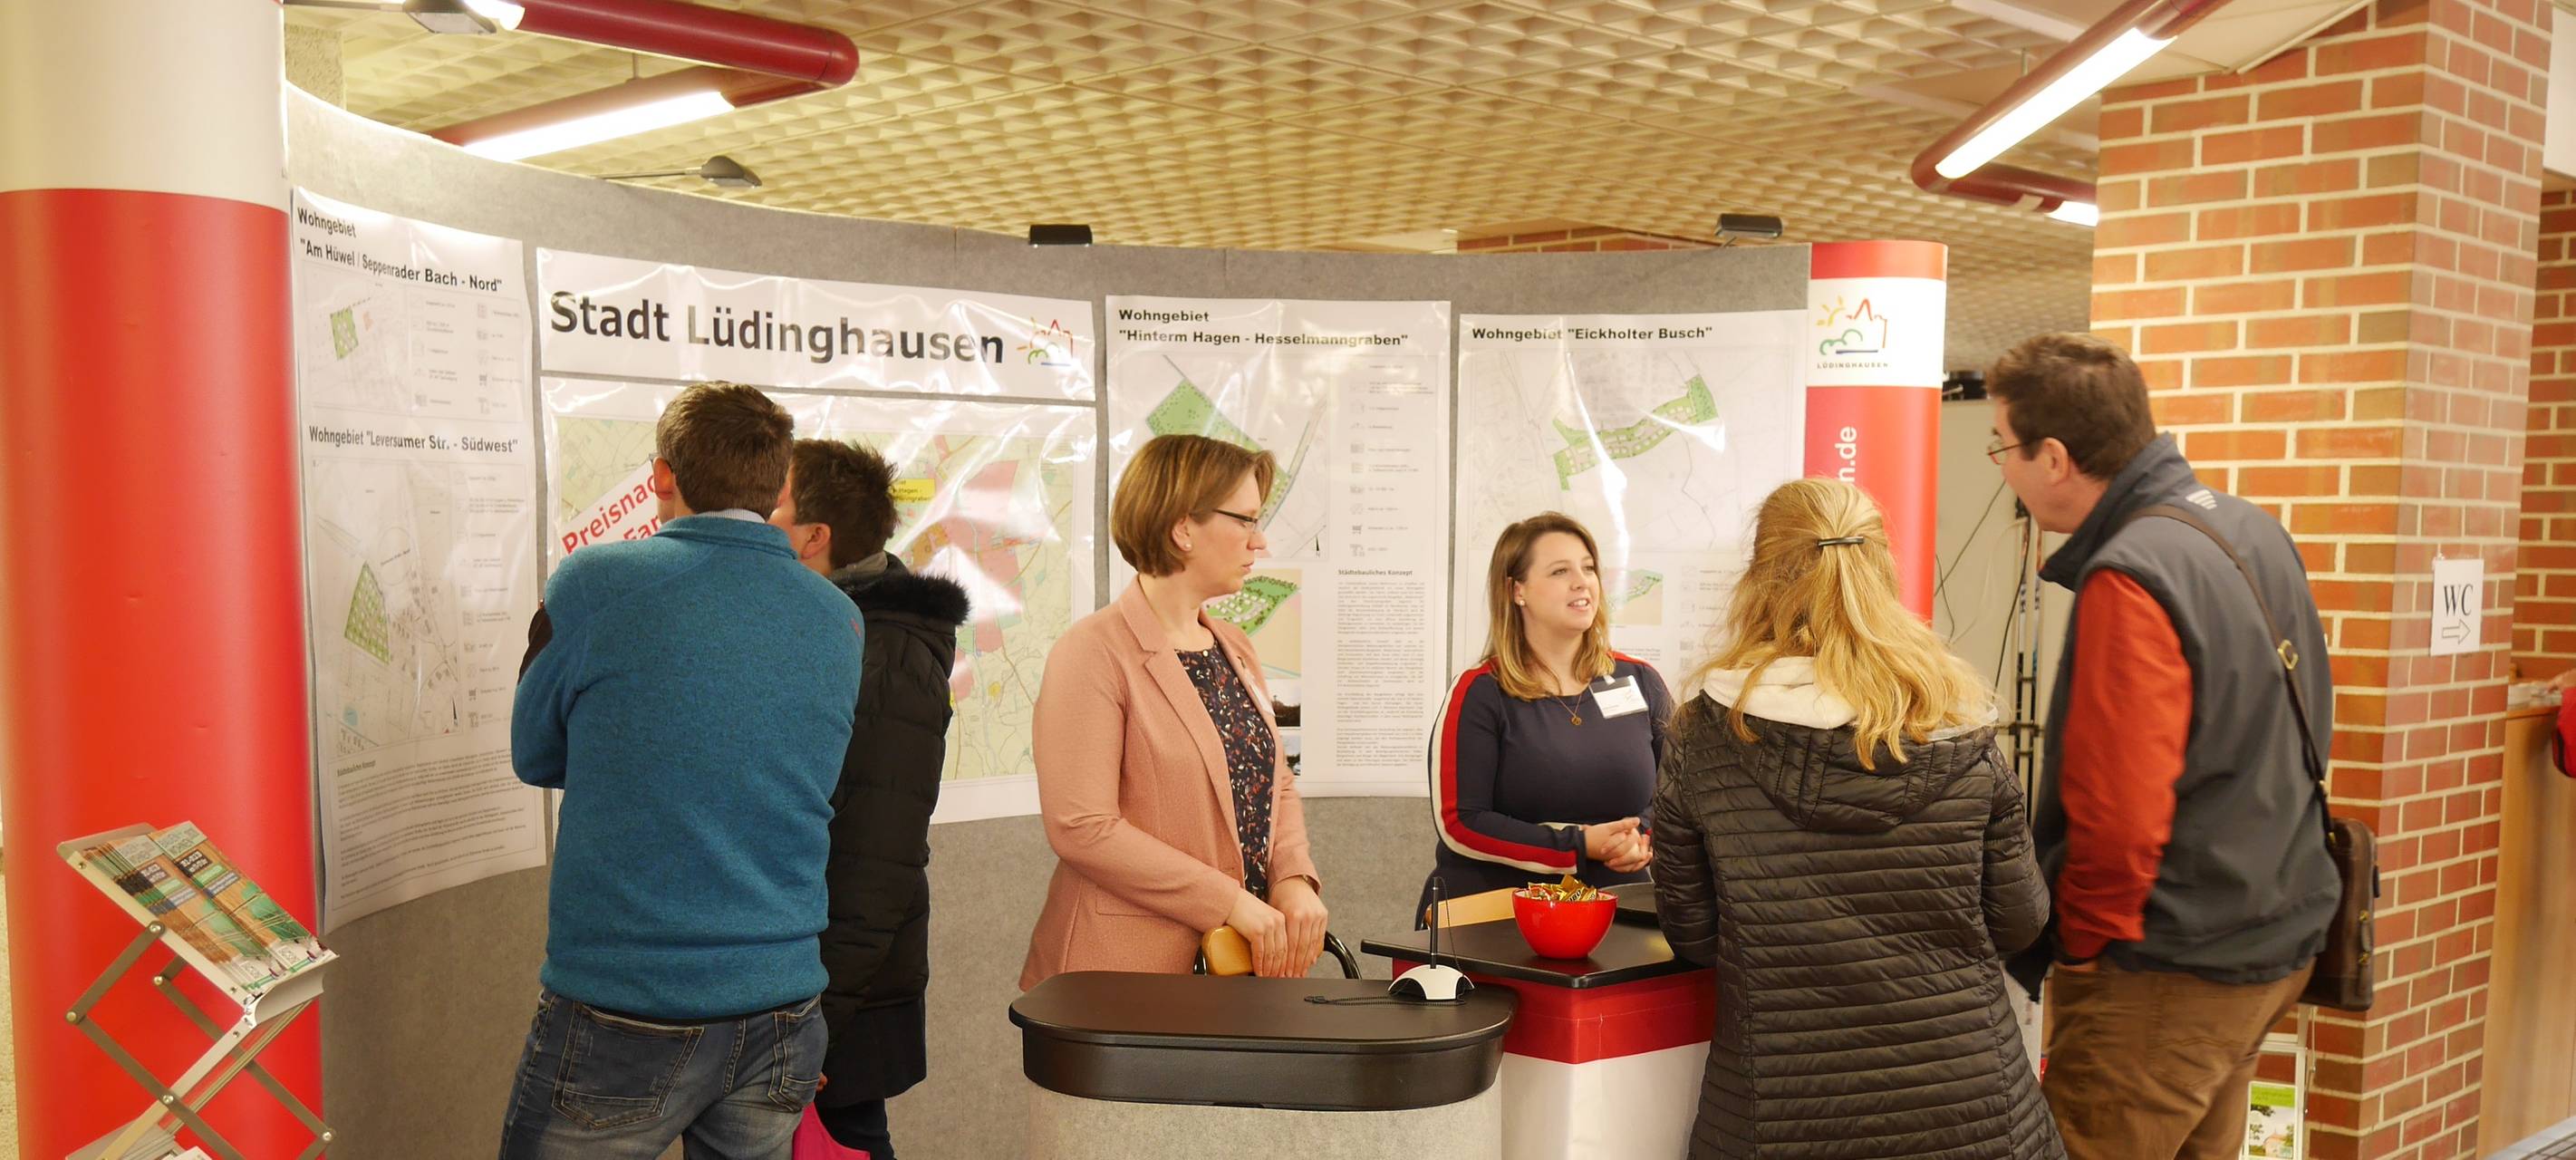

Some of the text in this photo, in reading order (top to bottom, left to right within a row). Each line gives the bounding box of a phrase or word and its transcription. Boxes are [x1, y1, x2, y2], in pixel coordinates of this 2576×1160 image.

[297, 207, 356, 237] Wohngebiet
[300, 238, 323, 257] "Am
[325, 244, 355, 266] Hüwel
[362, 253, 420, 281] Seppenrader
[425, 267, 458, 286] Bach
[469, 275, 502, 291] Nord"
[550, 291, 1003, 363] Stadt Lüdinghausen
[1119, 309, 1210, 324] Wohngebiet
[1119, 330, 1187, 342] "Hinterm
[1192, 332, 1240, 345] Hagen
[1255, 333, 1408, 347] Hesselmanngraben"
[1472, 326, 1713, 342] Wohngebiet "Eickholter Busch"
[309, 426, 363, 447] Wohngebiet
[366, 430, 426, 450] "Leversumer
[429, 435, 450, 450] Str.
[461, 437, 518, 453] Südwest"
[562, 475, 654, 555] Preisnac
[2443, 584, 2474, 616] WC
